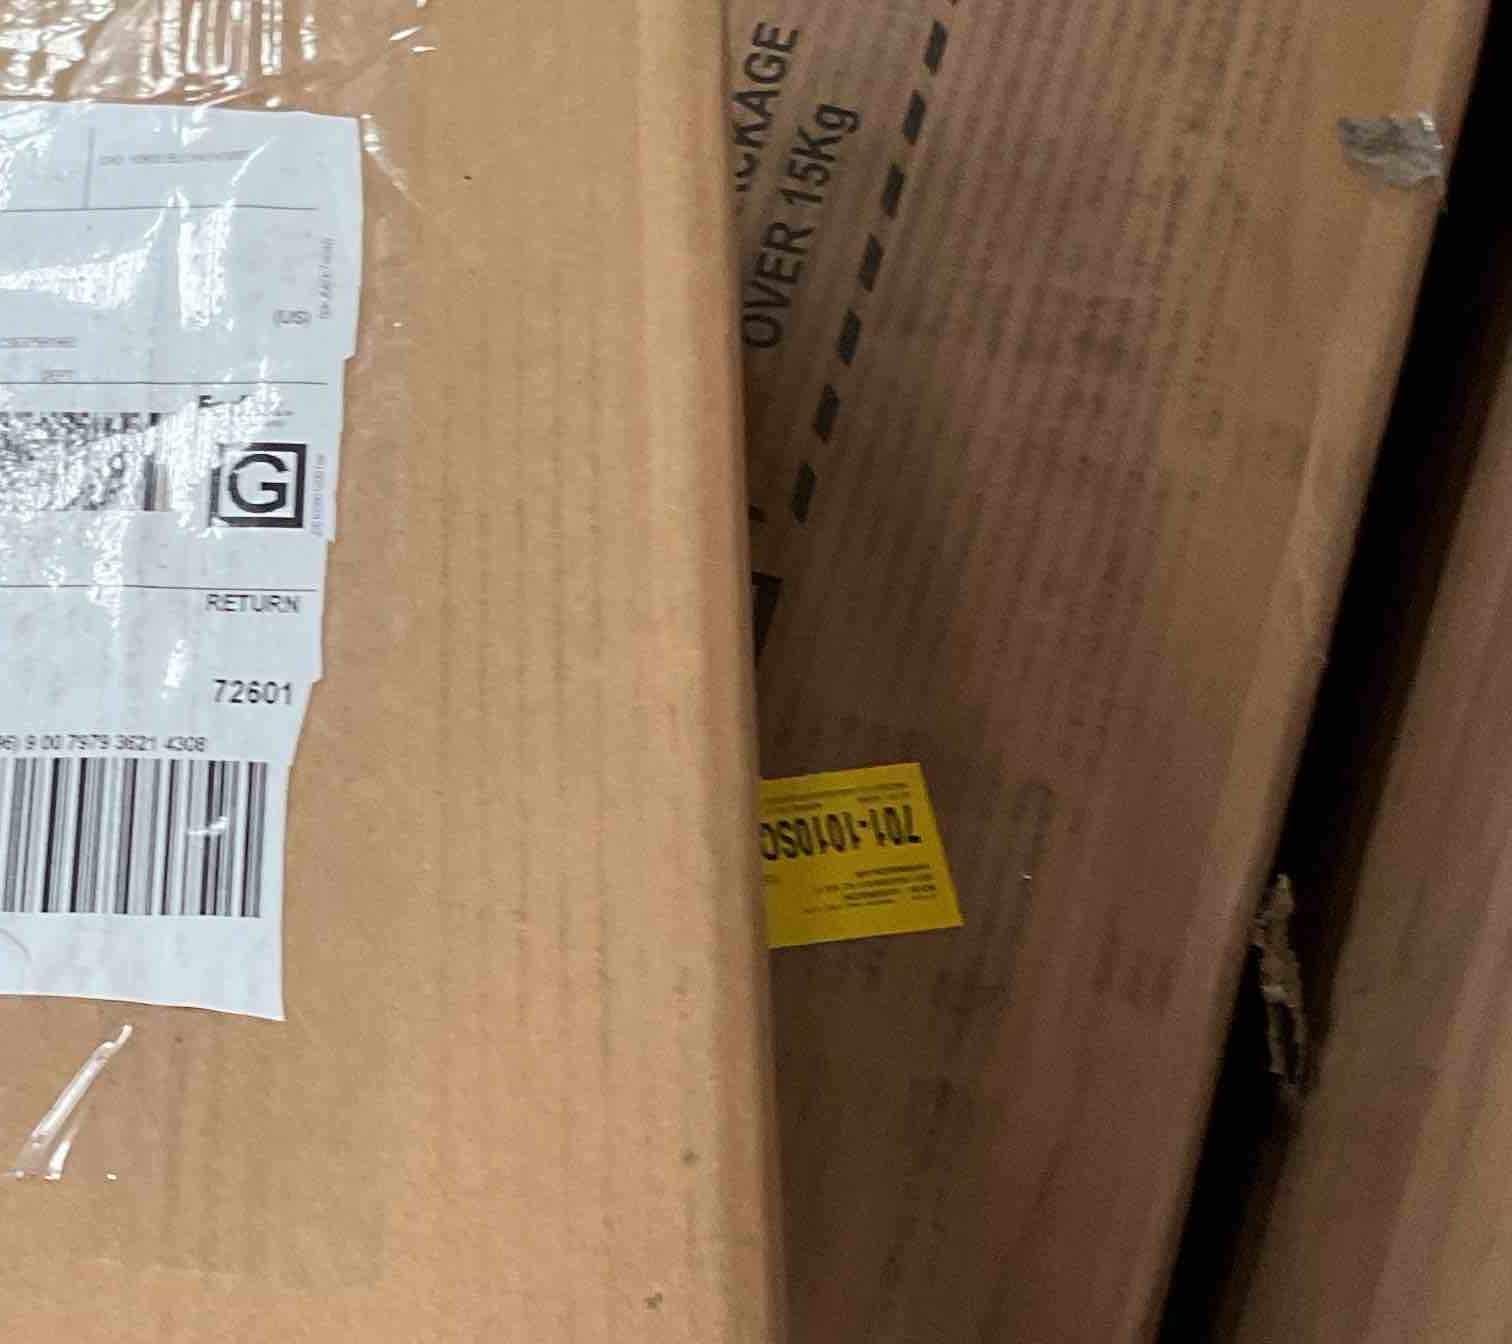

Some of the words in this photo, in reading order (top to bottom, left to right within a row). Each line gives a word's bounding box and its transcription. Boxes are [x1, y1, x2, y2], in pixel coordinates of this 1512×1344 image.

[742, 222, 815, 349] OVER
[784, 103, 861, 203] 15Kg
[273, 309, 312, 328] (US)
[228, 453, 289, 514] G
[206, 593, 301, 613] RETURN
[213, 679, 293, 706] 72601
[67, 734, 110, 751] 7979
[114, 735, 157, 752] 3621
[163, 736, 208, 753] 4308
